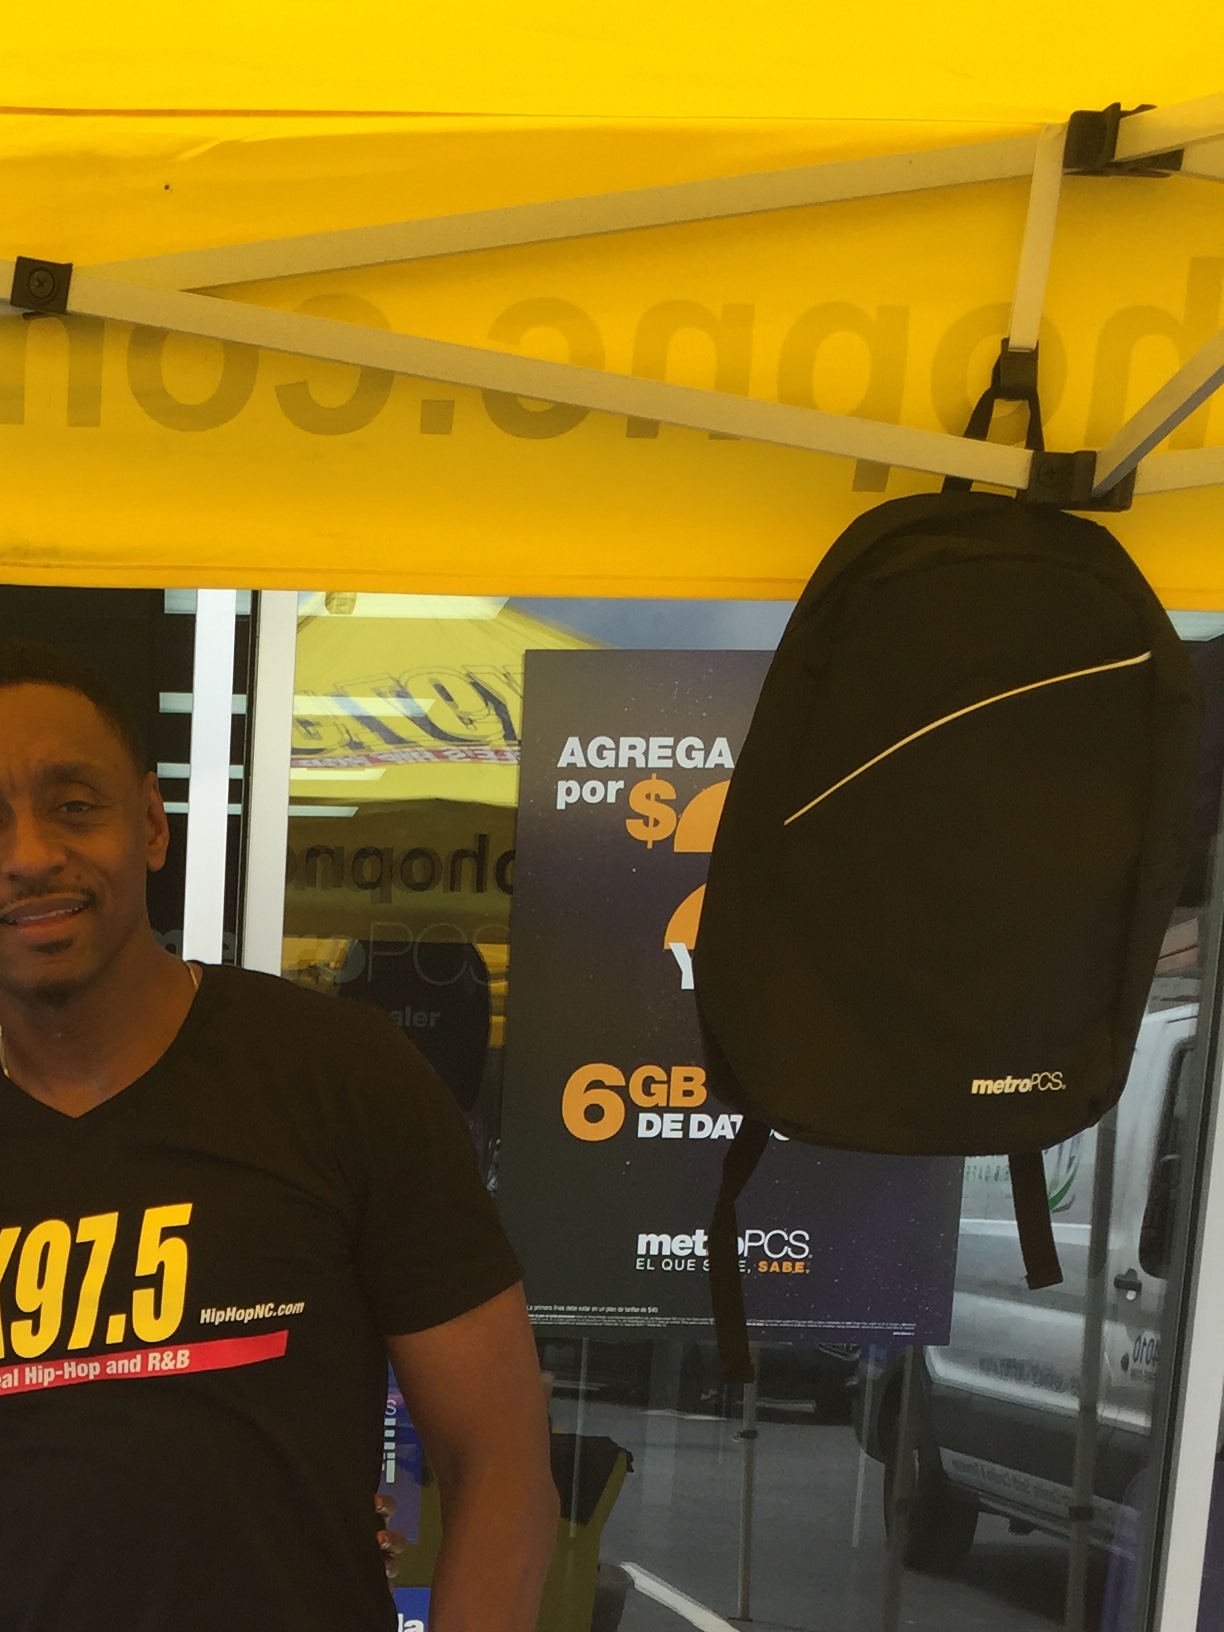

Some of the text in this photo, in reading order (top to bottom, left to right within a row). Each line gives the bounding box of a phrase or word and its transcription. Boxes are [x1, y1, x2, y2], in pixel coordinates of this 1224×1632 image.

[556, 736, 735, 769] AGREGA
[556, 780, 625, 810] por
[637, 1112, 684, 1139] DE
[636, 1258, 655, 1271] EL
[662, 1259, 696, 1272] QUE
[199, 1301, 305, 1326] HipHopNC.com
[24, 1361, 101, 1387] Hip-Hop
[105, 1354, 142, 1375] and
[147, 1349, 191, 1372] R&B
